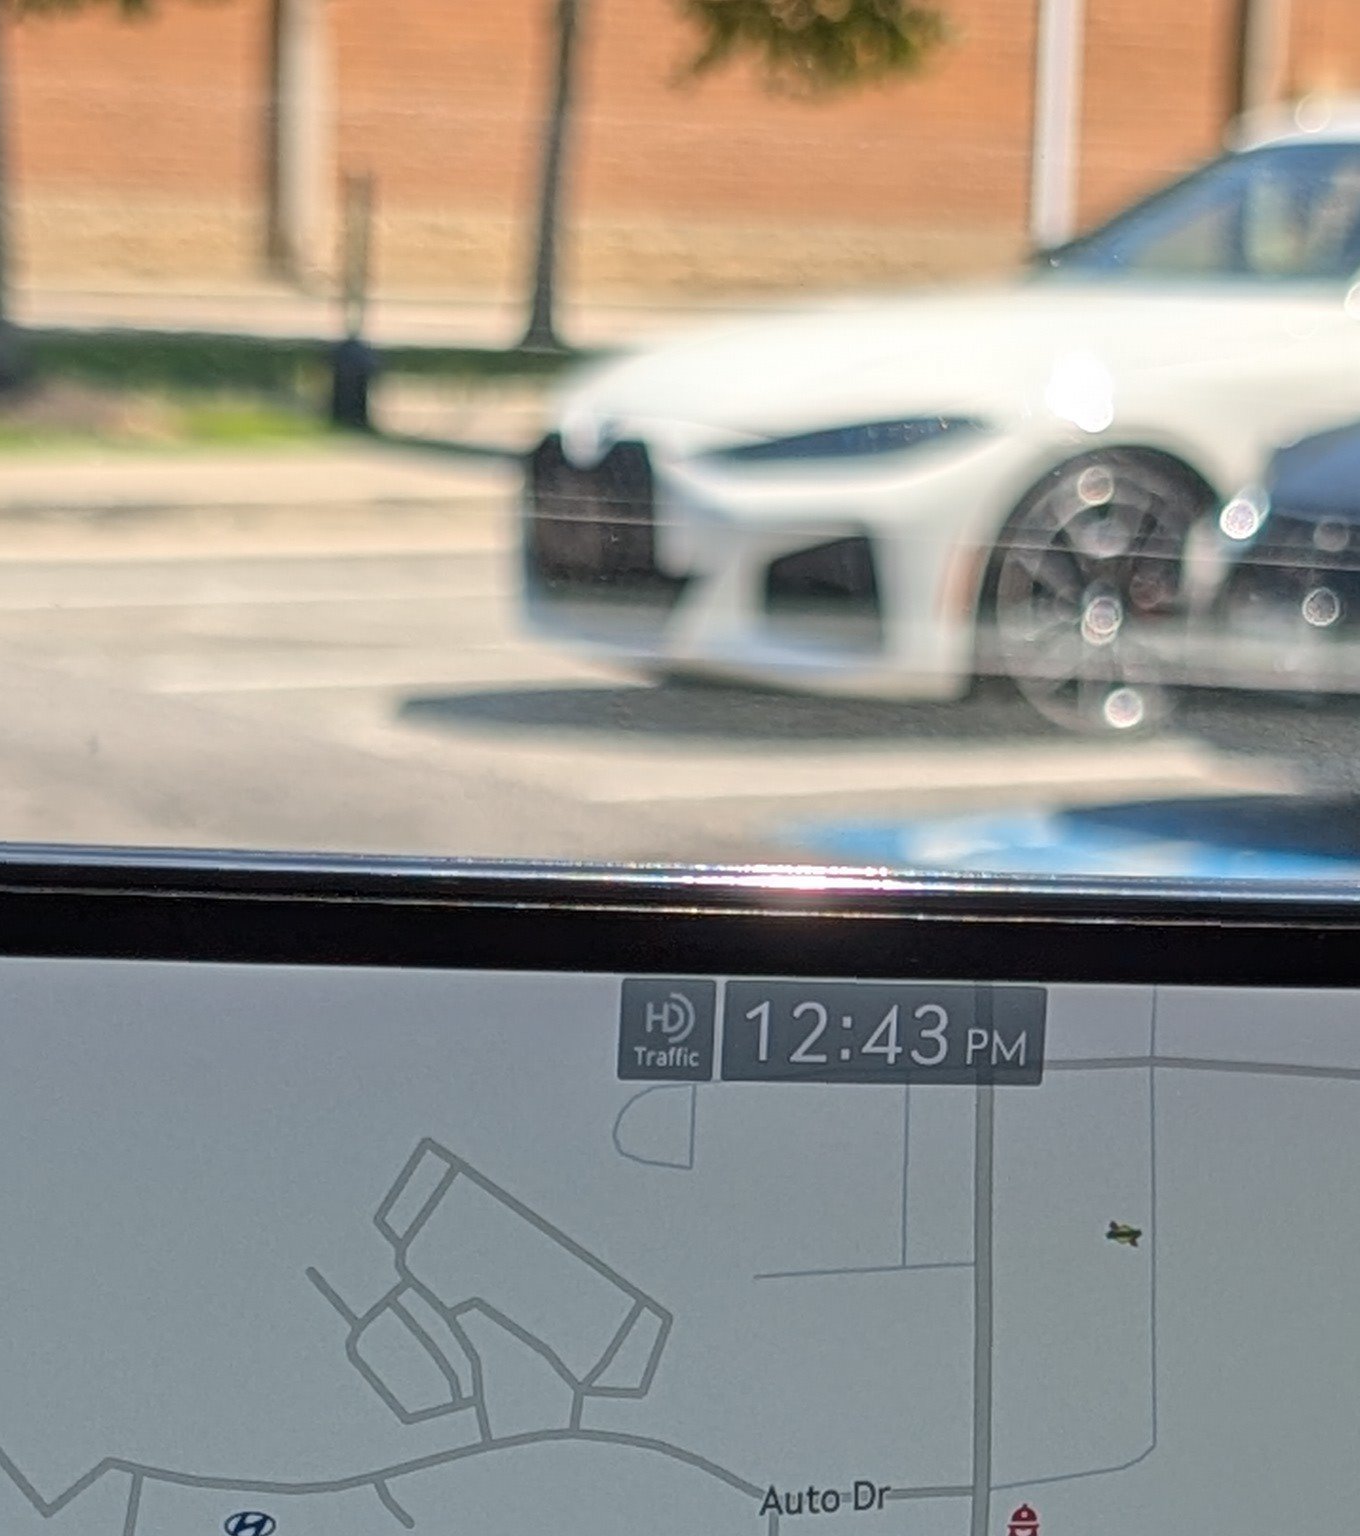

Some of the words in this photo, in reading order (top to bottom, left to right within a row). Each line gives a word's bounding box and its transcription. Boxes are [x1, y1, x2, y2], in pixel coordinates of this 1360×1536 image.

[744, 1000, 950, 1066] 12:43
[965, 1028, 1028, 1067] PM
[633, 1046, 700, 1068] Traffic
[759, 1484, 841, 1517] Auto
[853, 1480, 891, 1511] Dr
